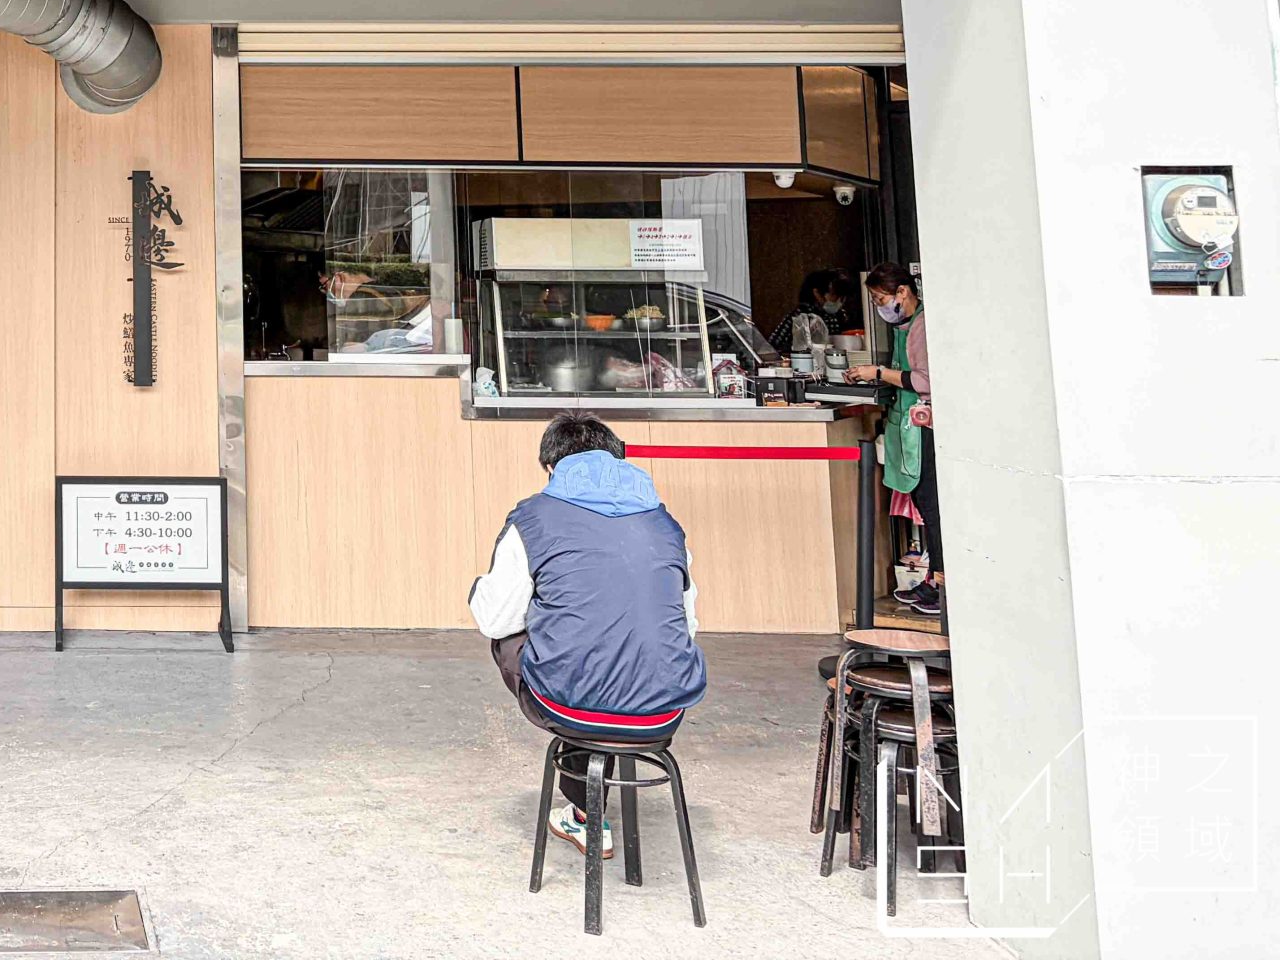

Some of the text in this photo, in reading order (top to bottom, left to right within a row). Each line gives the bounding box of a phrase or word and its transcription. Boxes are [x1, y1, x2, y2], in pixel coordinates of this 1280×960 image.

[119, 492, 165, 503] 營業時間
[94, 511, 192, 522] 中午 11:30-2:00
[92, 527, 193, 538] 下午 4:30-10:00
